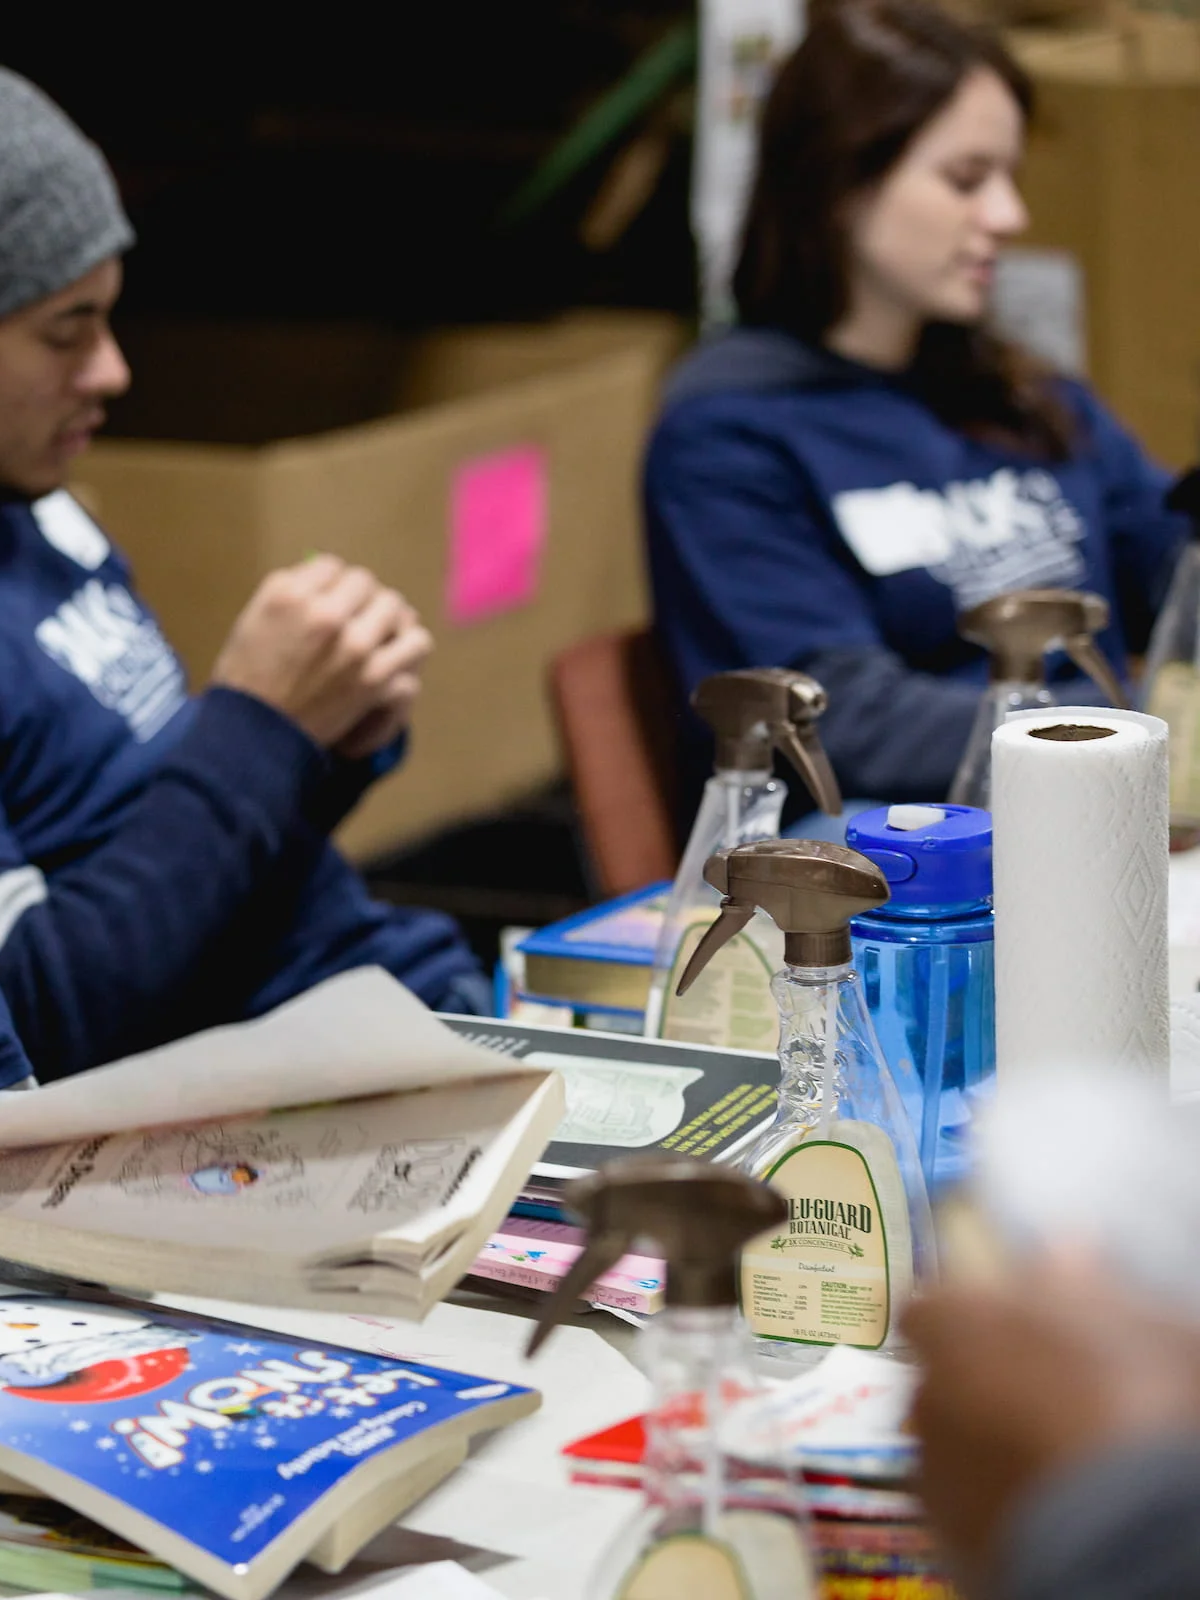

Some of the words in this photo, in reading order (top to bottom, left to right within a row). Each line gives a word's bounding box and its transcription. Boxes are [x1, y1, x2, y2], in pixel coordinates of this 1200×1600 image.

[789, 1220, 852, 1241] BOTANICAL
[798, 1239, 846, 1251] CONCENTRATE
[318, 1368, 439, 1407] Let
[111, 1350, 351, 1471] SNOW!
